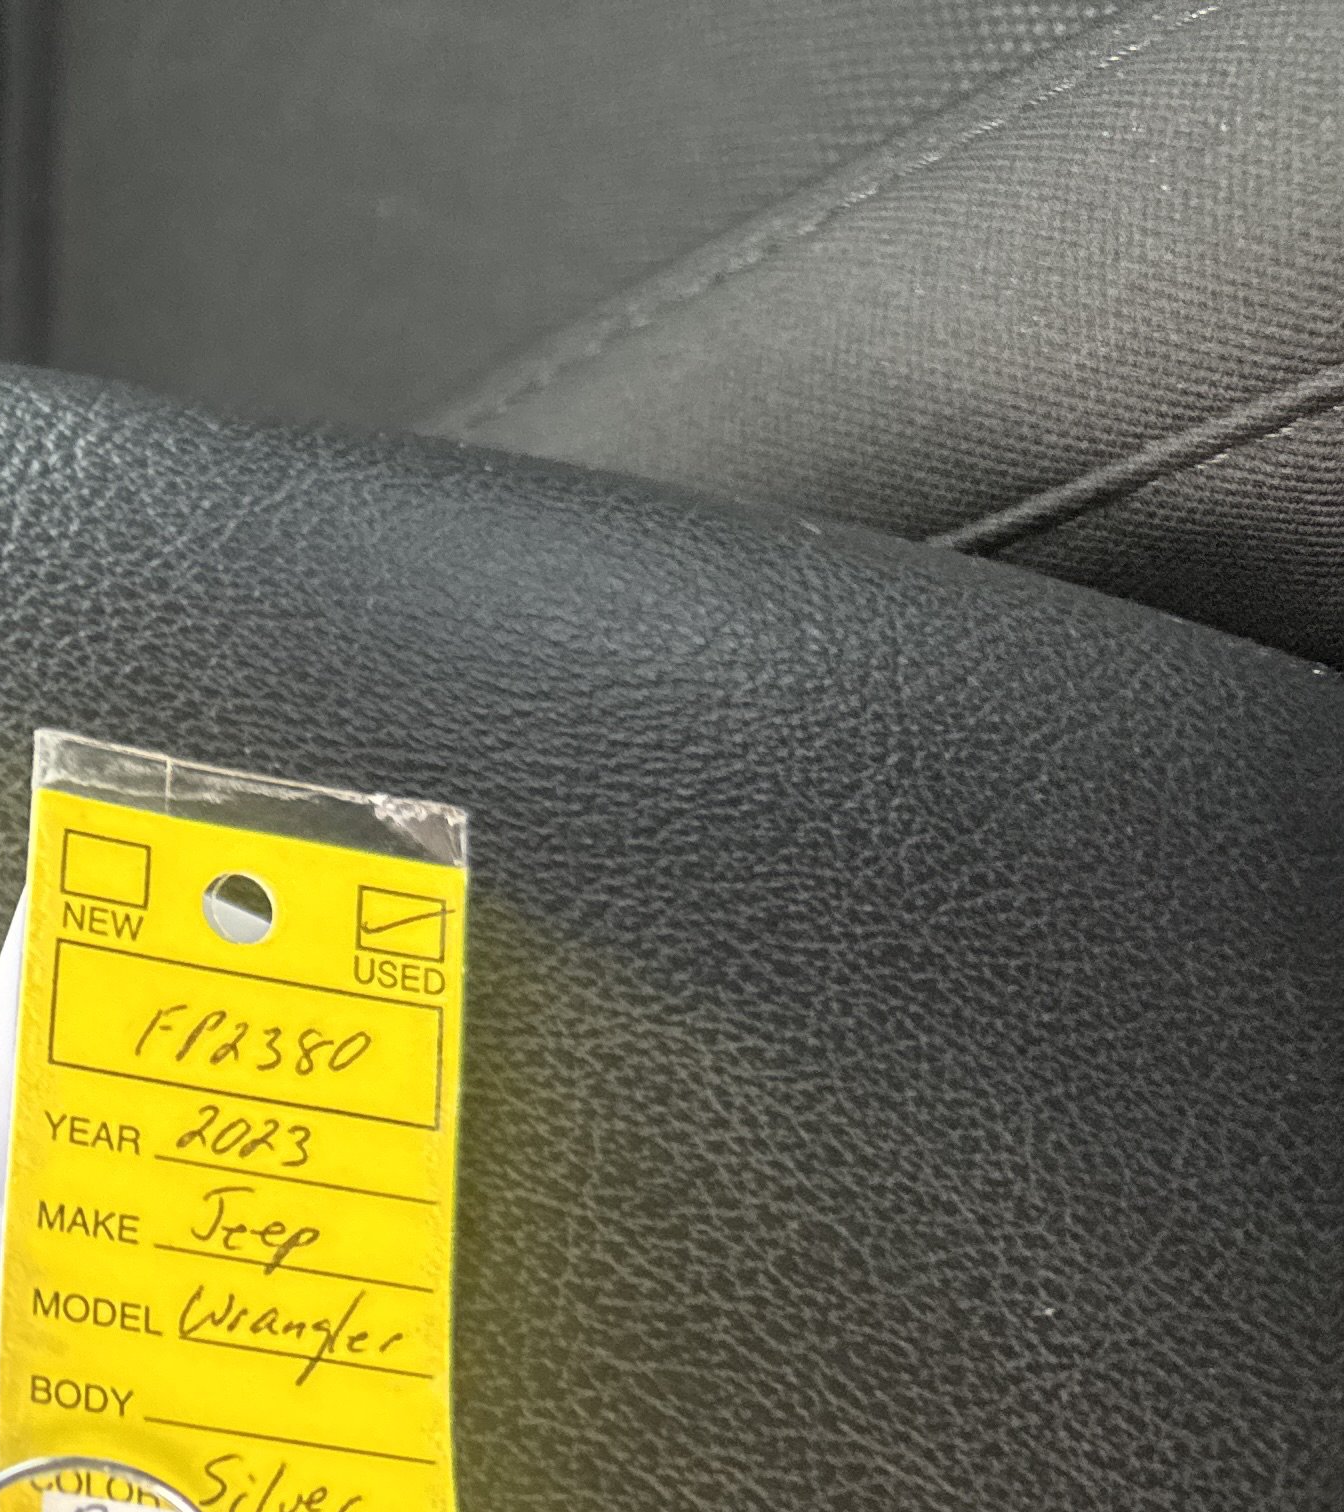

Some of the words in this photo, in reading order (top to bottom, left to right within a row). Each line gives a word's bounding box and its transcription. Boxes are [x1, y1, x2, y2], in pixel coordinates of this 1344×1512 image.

[62, 900, 144, 941] NEW
[353, 955, 446, 996] USED
[134, 1002, 372, 1077] FP2380
[44, 1110, 141, 1156] YEAR
[175, 1103, 312, 1167] 2023
[37, 1200, 140, 1245] MAKE
[190, 1185, 321, 1276] Jeep
[31, 1287, 163, 1336] MODEL
[178, 1283, 404, 1385] Wrangler
[29, 1374, 134, 1417] BODY
